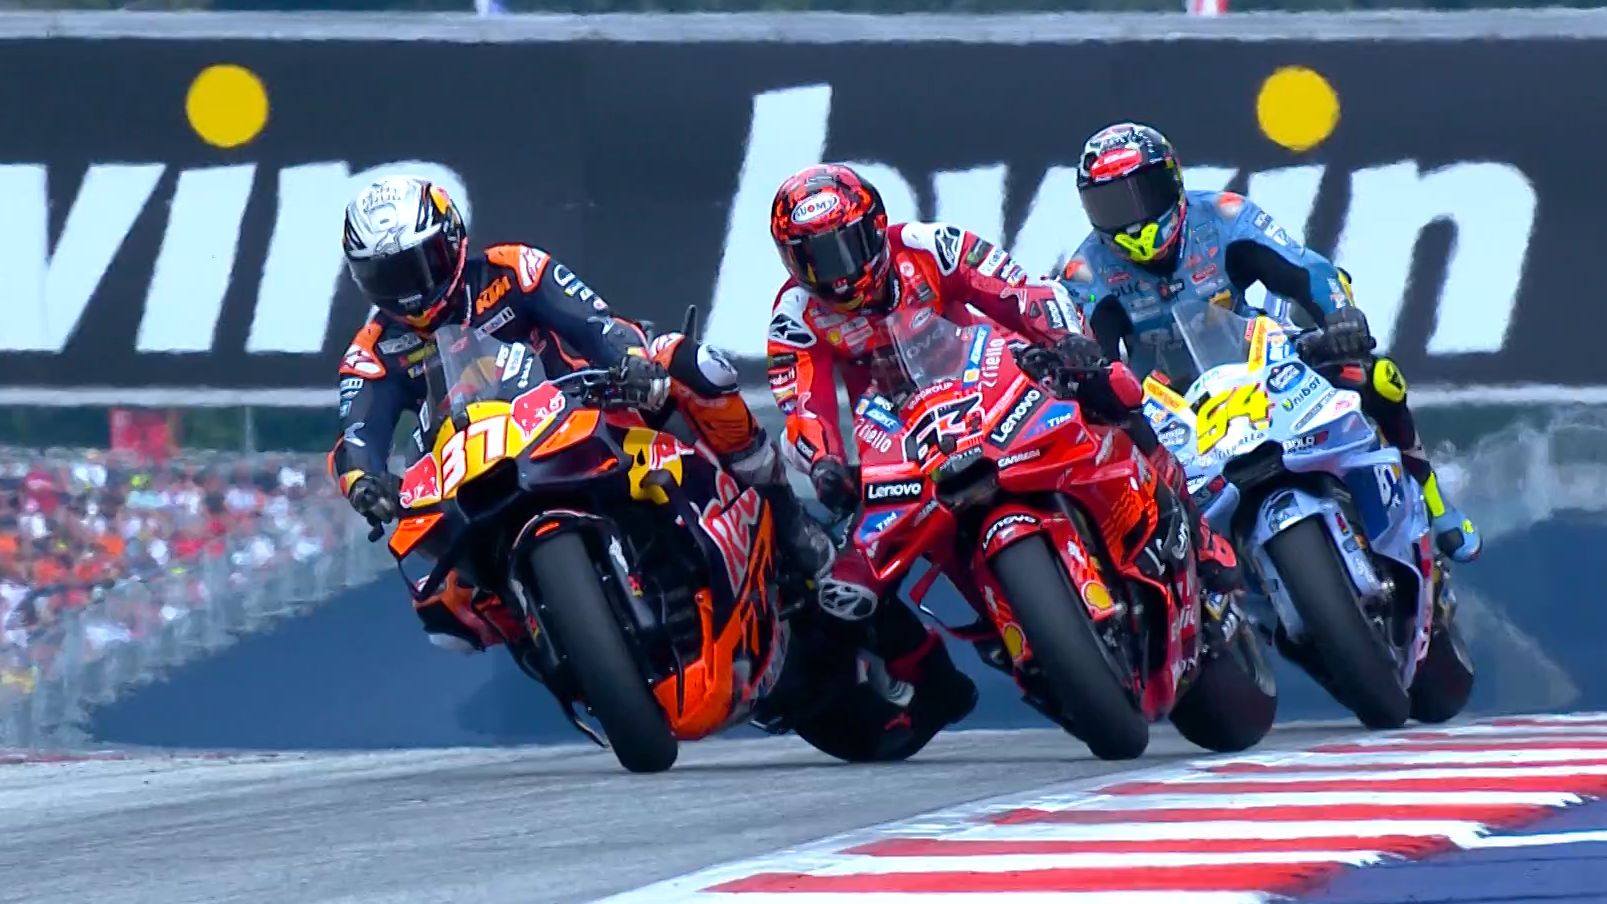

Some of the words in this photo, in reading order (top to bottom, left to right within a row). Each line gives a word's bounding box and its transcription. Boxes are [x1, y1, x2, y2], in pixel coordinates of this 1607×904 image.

[475, 276, 512, 315] KTM
[991, 389, 1041, 444] Lenovo
[1196, 382, 1273, 454] 54
[441, 415, 508, 495] 37
[868, 482, 922, 500] Lenovo
[982, 514, 1037, 551] Lenovo
